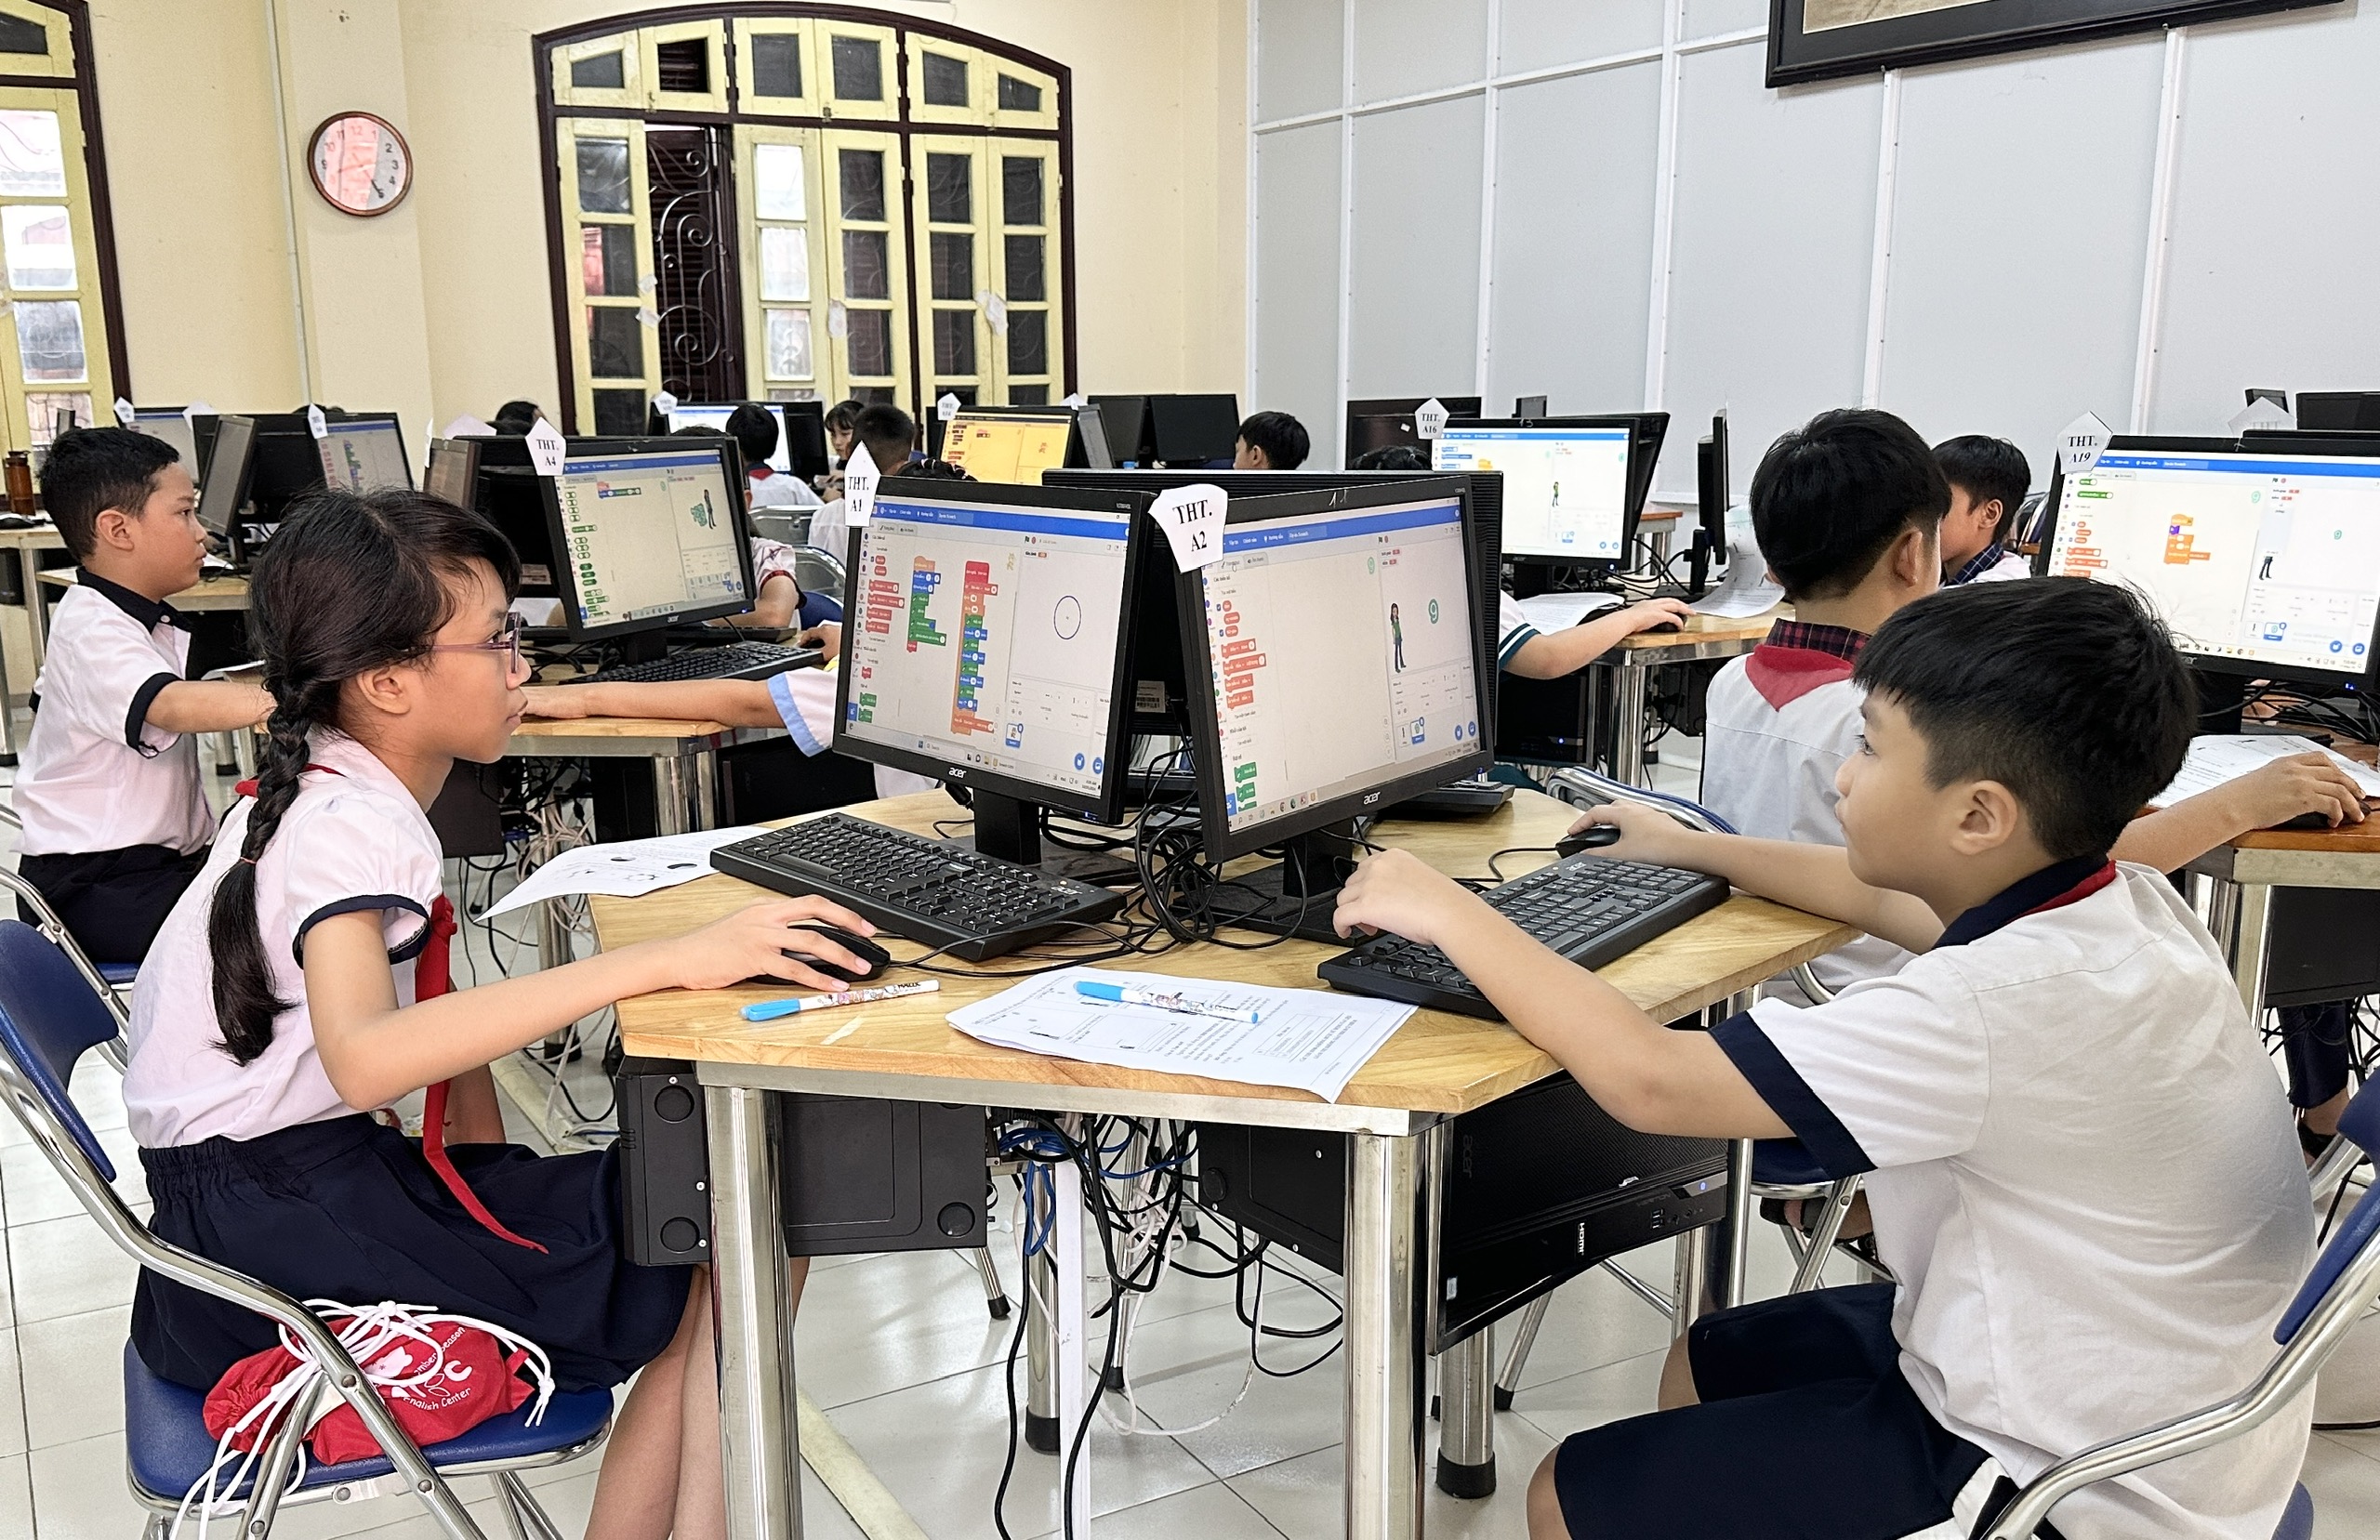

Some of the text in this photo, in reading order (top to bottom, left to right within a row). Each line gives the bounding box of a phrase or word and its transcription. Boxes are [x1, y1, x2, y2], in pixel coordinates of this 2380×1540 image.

[337, 130, 345, 140] 11
[350, 125, 363, 136] 12
[325, 142, 336, 151] 10
[385, 143, 393, 153] 2
[391, 160, 399, 170] 3
[389, 176, 396, 185] 4
[2068, 435, 2097, 447] THT.
[545, 455, 557, 467] A4
[2069, 452, 2091, 464] A19
[848, 476, 869, 491] THT.
[850, 498, 863, 512] A1
[1172, 499, 1212, 524] THT.
[1190, 531, 1208, 552] A2
[948, 767, 967, 779] acer
[1363, 791, 1382, 805] acer
[441, 1388, 471, 1407] Center
